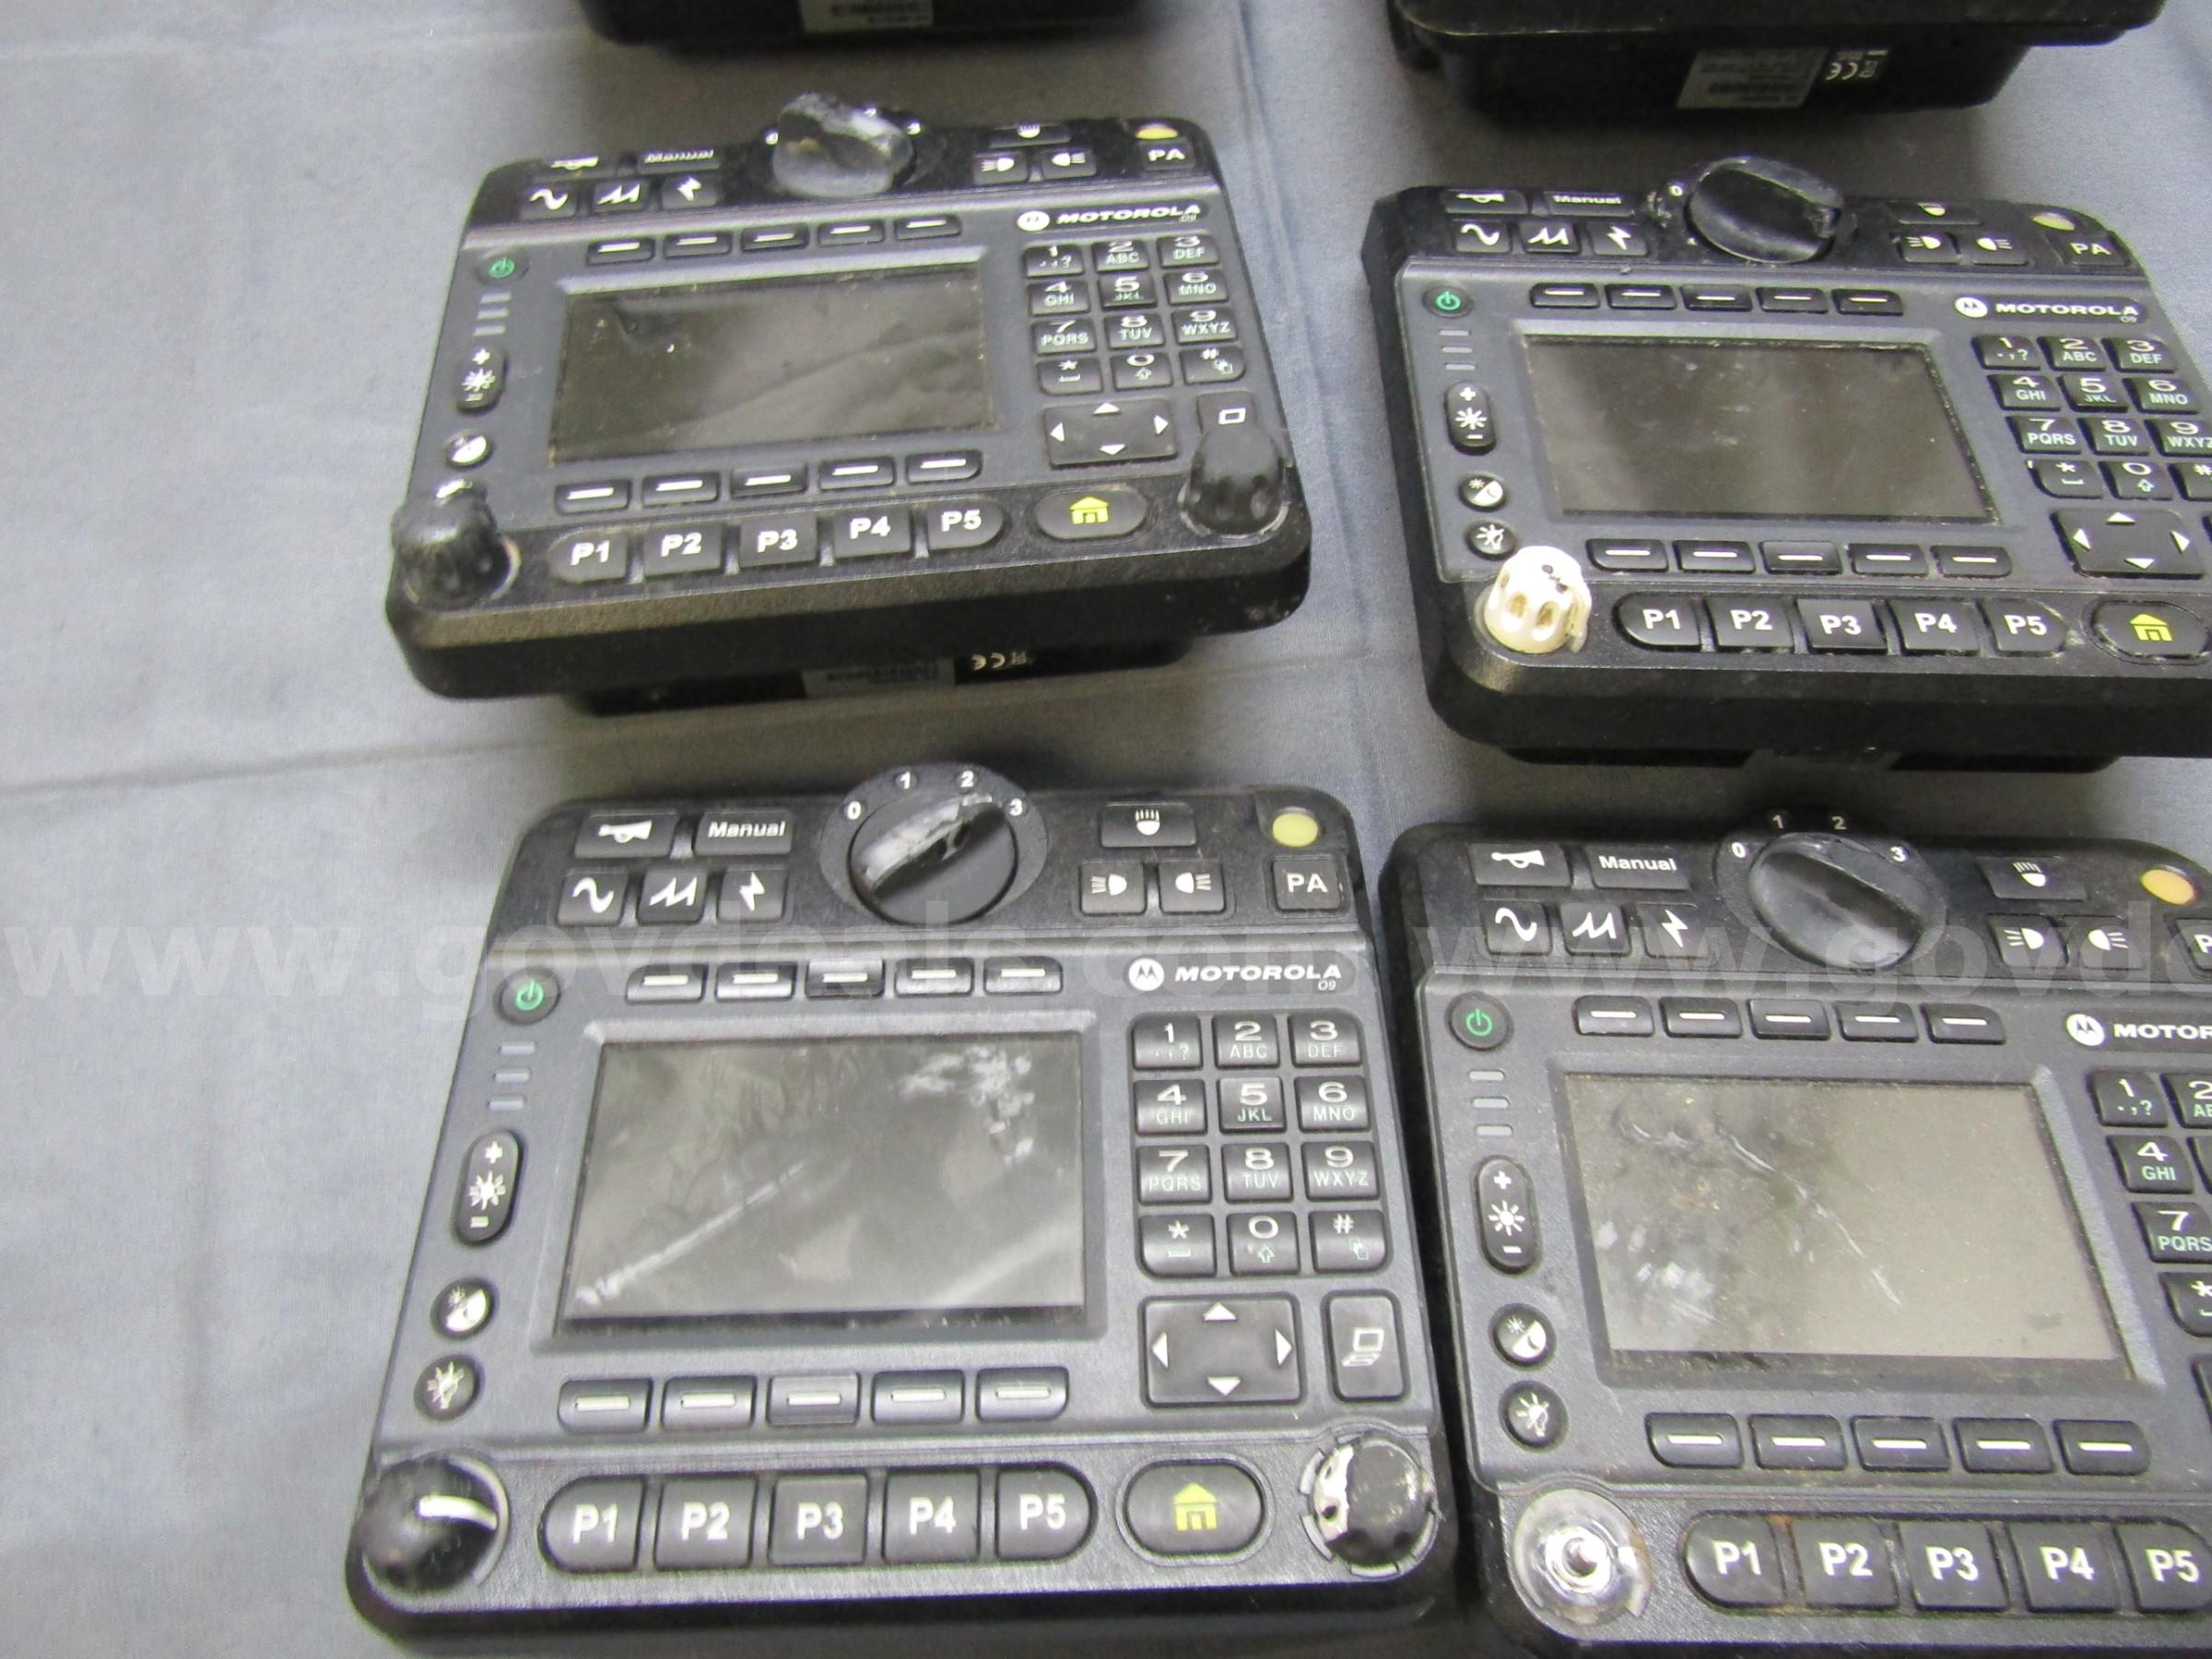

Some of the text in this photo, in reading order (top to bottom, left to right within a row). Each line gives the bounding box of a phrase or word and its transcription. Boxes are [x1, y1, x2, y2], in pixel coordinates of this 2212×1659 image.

[1148, 148, 1185, 161] PA
[1553, 194, 1621, 206] Manual
[1056, 205, 1201, 224] MOTOROLA
[1108, 241, 1134, 253] 2
[1174, 236, 1200, 247] 3
[2070, 241, 2111, 255] PA
[1106, 252, 1139, 265] ABC
[1172, 246, 1206, 260] DEF
[1045, 281, 1071, 293] 4
[1114, 276, 1140, 292] 5
[1178, 283, 1217, 296] MNO
[1044, 293, 1074, 306] GHI
[1190, 309, 1217, 323] 9
[1995, 302, 2139, 317] MOTOROLA
[1053, 320, 1076, 333] 7
[1121, 315, 1147, 328] 8
[1181, 322, 1230, 335] WXYZ
[1041, 332, 1088, 347] PQRS
[1120, 327, 1152, 341] TUV
[1999, 337, 2013, 348] 1
[2060, 338, 2088, 350] 2
[2126, 339, 2155, 351] 3
[2062, 351, 2098, 362] ABC
[2130, 353, 2162, 364] DEF
[2013, 376, 2040, 388] 4
[2079, 378, 2106, 393] 5
[2147, 380, 2177, 392] 6
[2016, 390, 2046, 401] GHI
[2084, 394, 2116, 403] JKL
[2149, 393, 2188, 405] MNO
[2030, 418, 2055, 430] 7
[2100, 419, 2131, 432] 8
[2171, 421, 2199, 435] 9
[2027, 433, 2077, 445] PQRS
[2104, 434, 2137, 446] TUV
[2167, 436, 2212, 448] WXYZ
[571, 509, 982, 566] P1 P2 P3 P4 P5
[1642, 609, 2047, 636] P1 P2 P3 P4 P5
[900, 772, 912, 790] 1
[959, 771, 974, 788] 2
[848, 801, 861, 818] 0
[1010, 800, 1023, 817] 3
[708, 820, 785, 839] Manual
[1772, 815, 1784, 830] 1
[1832, 816, 1846, 830] 2
[1732, 841, 1747, 858] 0
[1891, 847, 1906, 862] 3
[1599, 855, 1677, 872] Manual
[1288, 873, 1328, 893] PA
[1175, 964, 1342, 982] MOTOROLA
[1165, 1023, 1175, 1043] 1
[1233, 1020, 1263, 1041] 2
[1310, 1020, 1338, 1041] 3
[2113, 1023, 2212, 1039] MOTOR
[1230, 1044, 1267, 1059] ABC
[1307, 1044, 1343, 1058] DEF
[1157, 1084, 1187, 1105] 4
[1239, 1083, 1268, 1106] 5
[1318, 1081, 1347, 1103] 6
[2119, 1078, 2135, 1098] 1
[2188, 1080, 2212, 1100] 2
[1156, 1110, 1189, 1125] GHI
[1237, 1108, 1273, 1123] JKL
[1312, 1107, 1357, 1122] MNO
[1244, 1147, 1275, 1171] 8
[1324, 1146, 1354, 1168] 9
[2136, 1142, 2168, 1161] 4
[1159, 1150, 1189, 1173] 7
[1241, 1173, 1278, 1189] TUV
[1313, 1171, 1370, 1187] WXYZ
[2142, 1166, 2176, 1181] GHI
[1148, 1176, 1202, 1192] PQRS
[2158, 1210, 2189, 1231] 7
[2158, 1236, 2212, 1251] PQRS
[573, 1494, 1066, 1544] P1 P2 P3 P4 P5
[1712, 1541, 2199, 1583] P1 P2 P3 P4 P5
